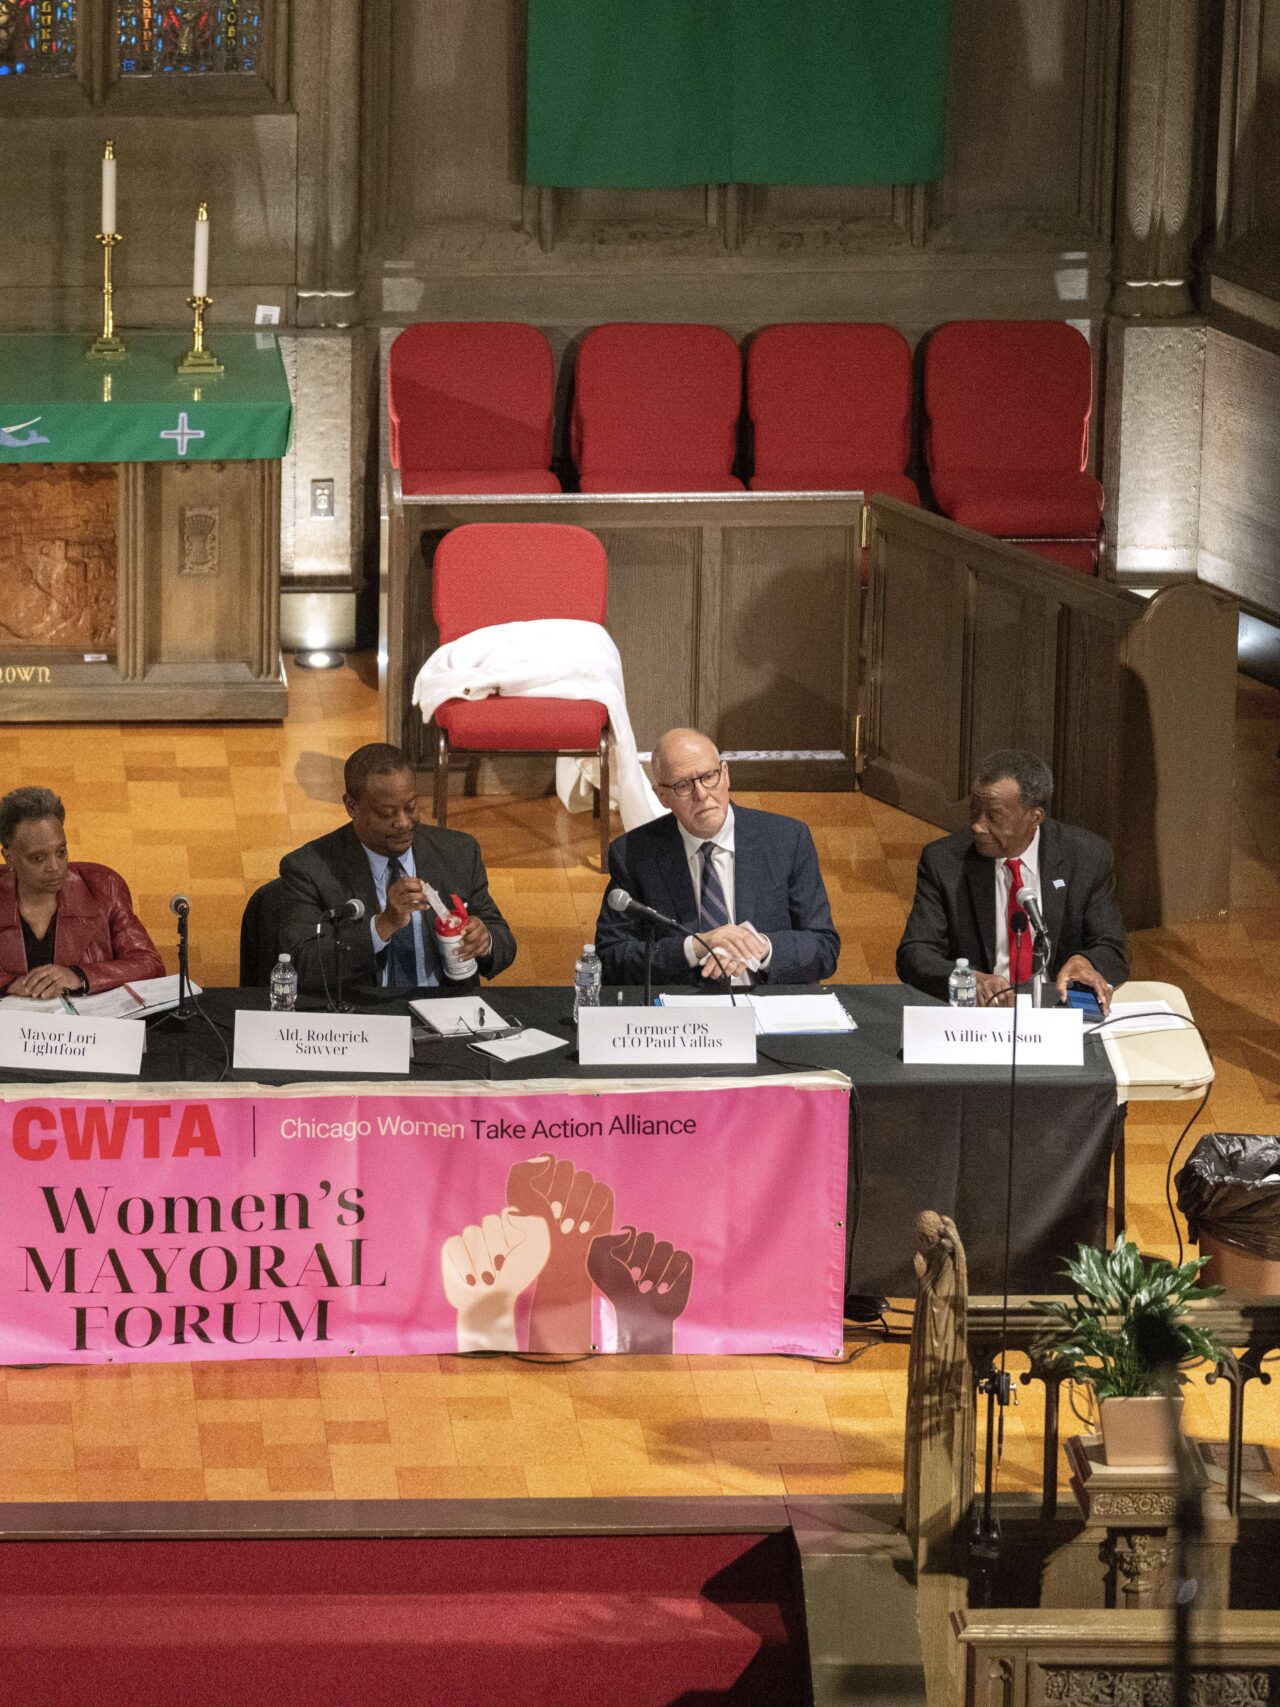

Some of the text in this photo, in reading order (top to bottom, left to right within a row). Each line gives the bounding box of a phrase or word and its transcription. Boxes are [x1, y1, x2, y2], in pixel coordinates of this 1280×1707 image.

[20, 1027, 97, 1045] Mayor Lori
[275, 1028, 369, 1043] Ald. Roderick
[626, 1023, 709, 1036] Former CPS
[944, 1030, 1042, 1044] Willie Wison
[23, 1041, 87, 1057] Lightfoot
[295, 1042, 348, 1056] Sawyer
[612, 1035, 723, 1049] CEO Paul Vallas
[12, 1103, 222, 1162] CWTA
[280, 1114, 697, 1141] Chicago Women Take Action Alliance
[37, 1180, 366, 1236] Women's
[17, 1238, 388, 1294] MAYORAL
[68, 1299, 335, 1351] FORUM
